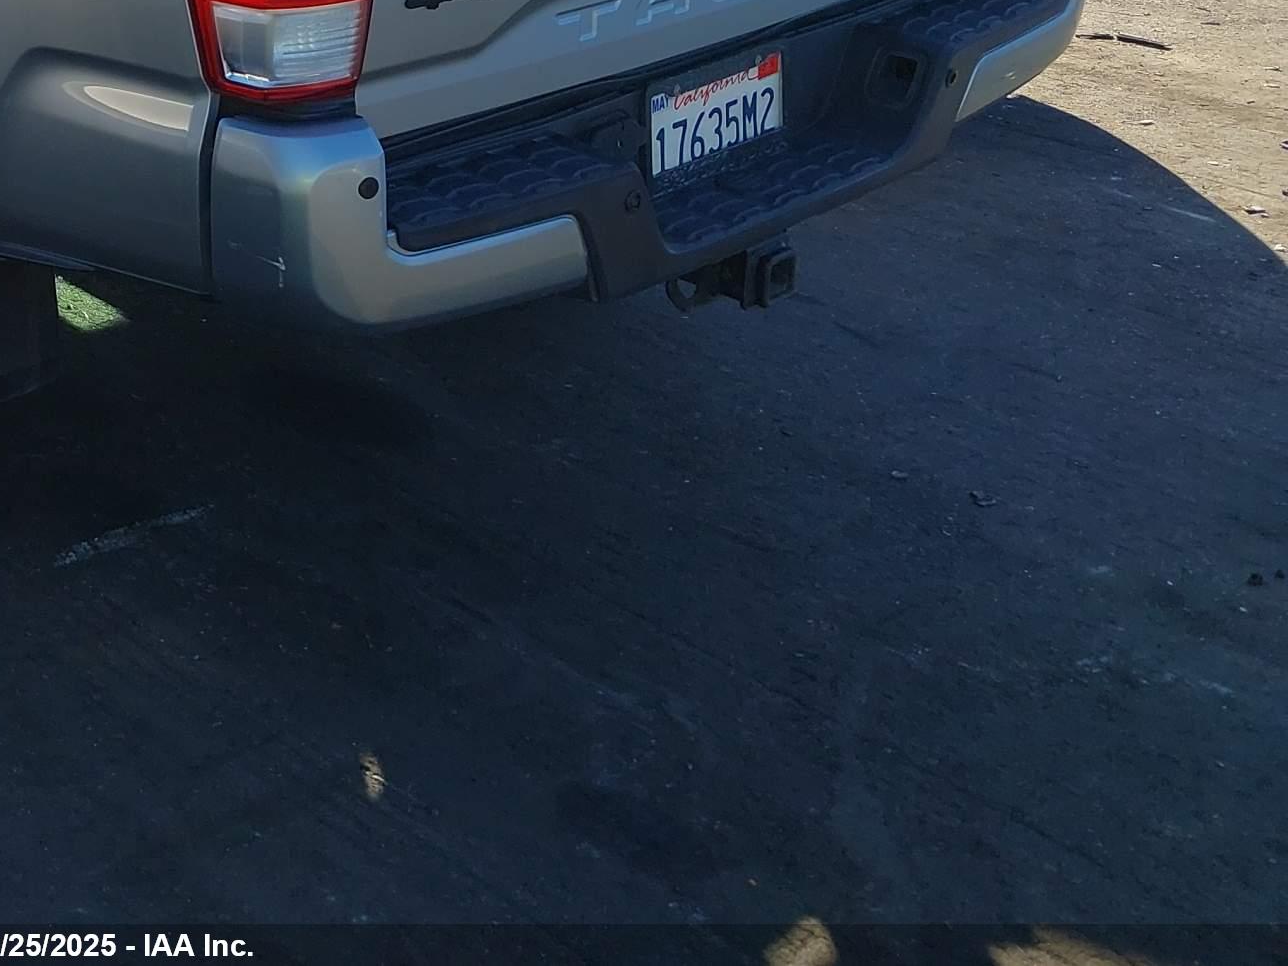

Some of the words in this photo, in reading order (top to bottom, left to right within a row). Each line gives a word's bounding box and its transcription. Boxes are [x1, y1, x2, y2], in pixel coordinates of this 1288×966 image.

[652, 92, 670, 113] MAY
[672, 67, 760, 111] California
[656, 86, 776, 172] 17635M2
